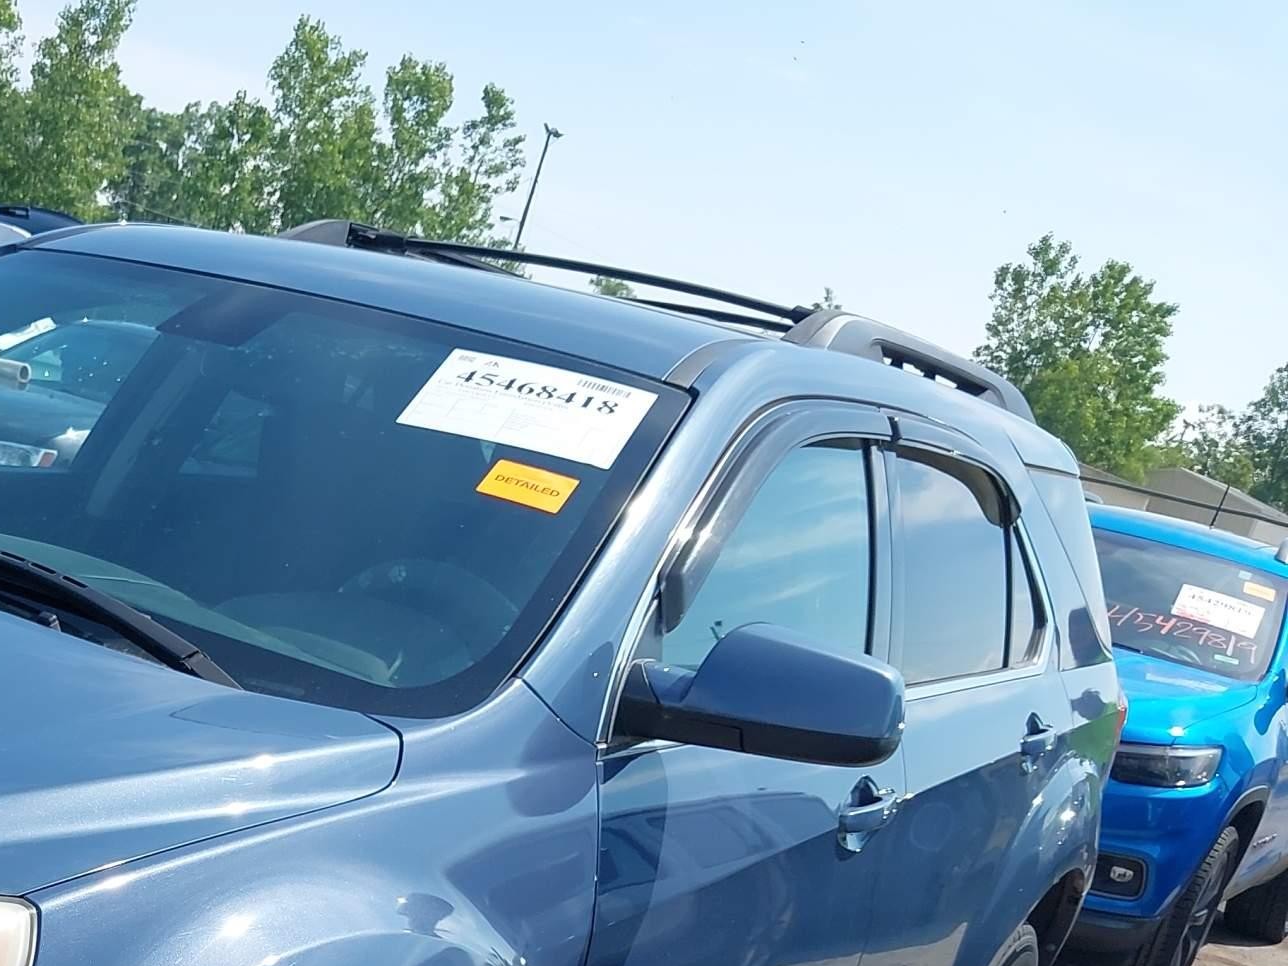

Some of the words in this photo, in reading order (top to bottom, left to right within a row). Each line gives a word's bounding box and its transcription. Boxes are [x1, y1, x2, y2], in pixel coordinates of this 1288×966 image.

[455, 369, 619, 415] 45468418
[494, 474, 560, 497] DETAILED
[1106, 604, 1259, 665] 45429819
